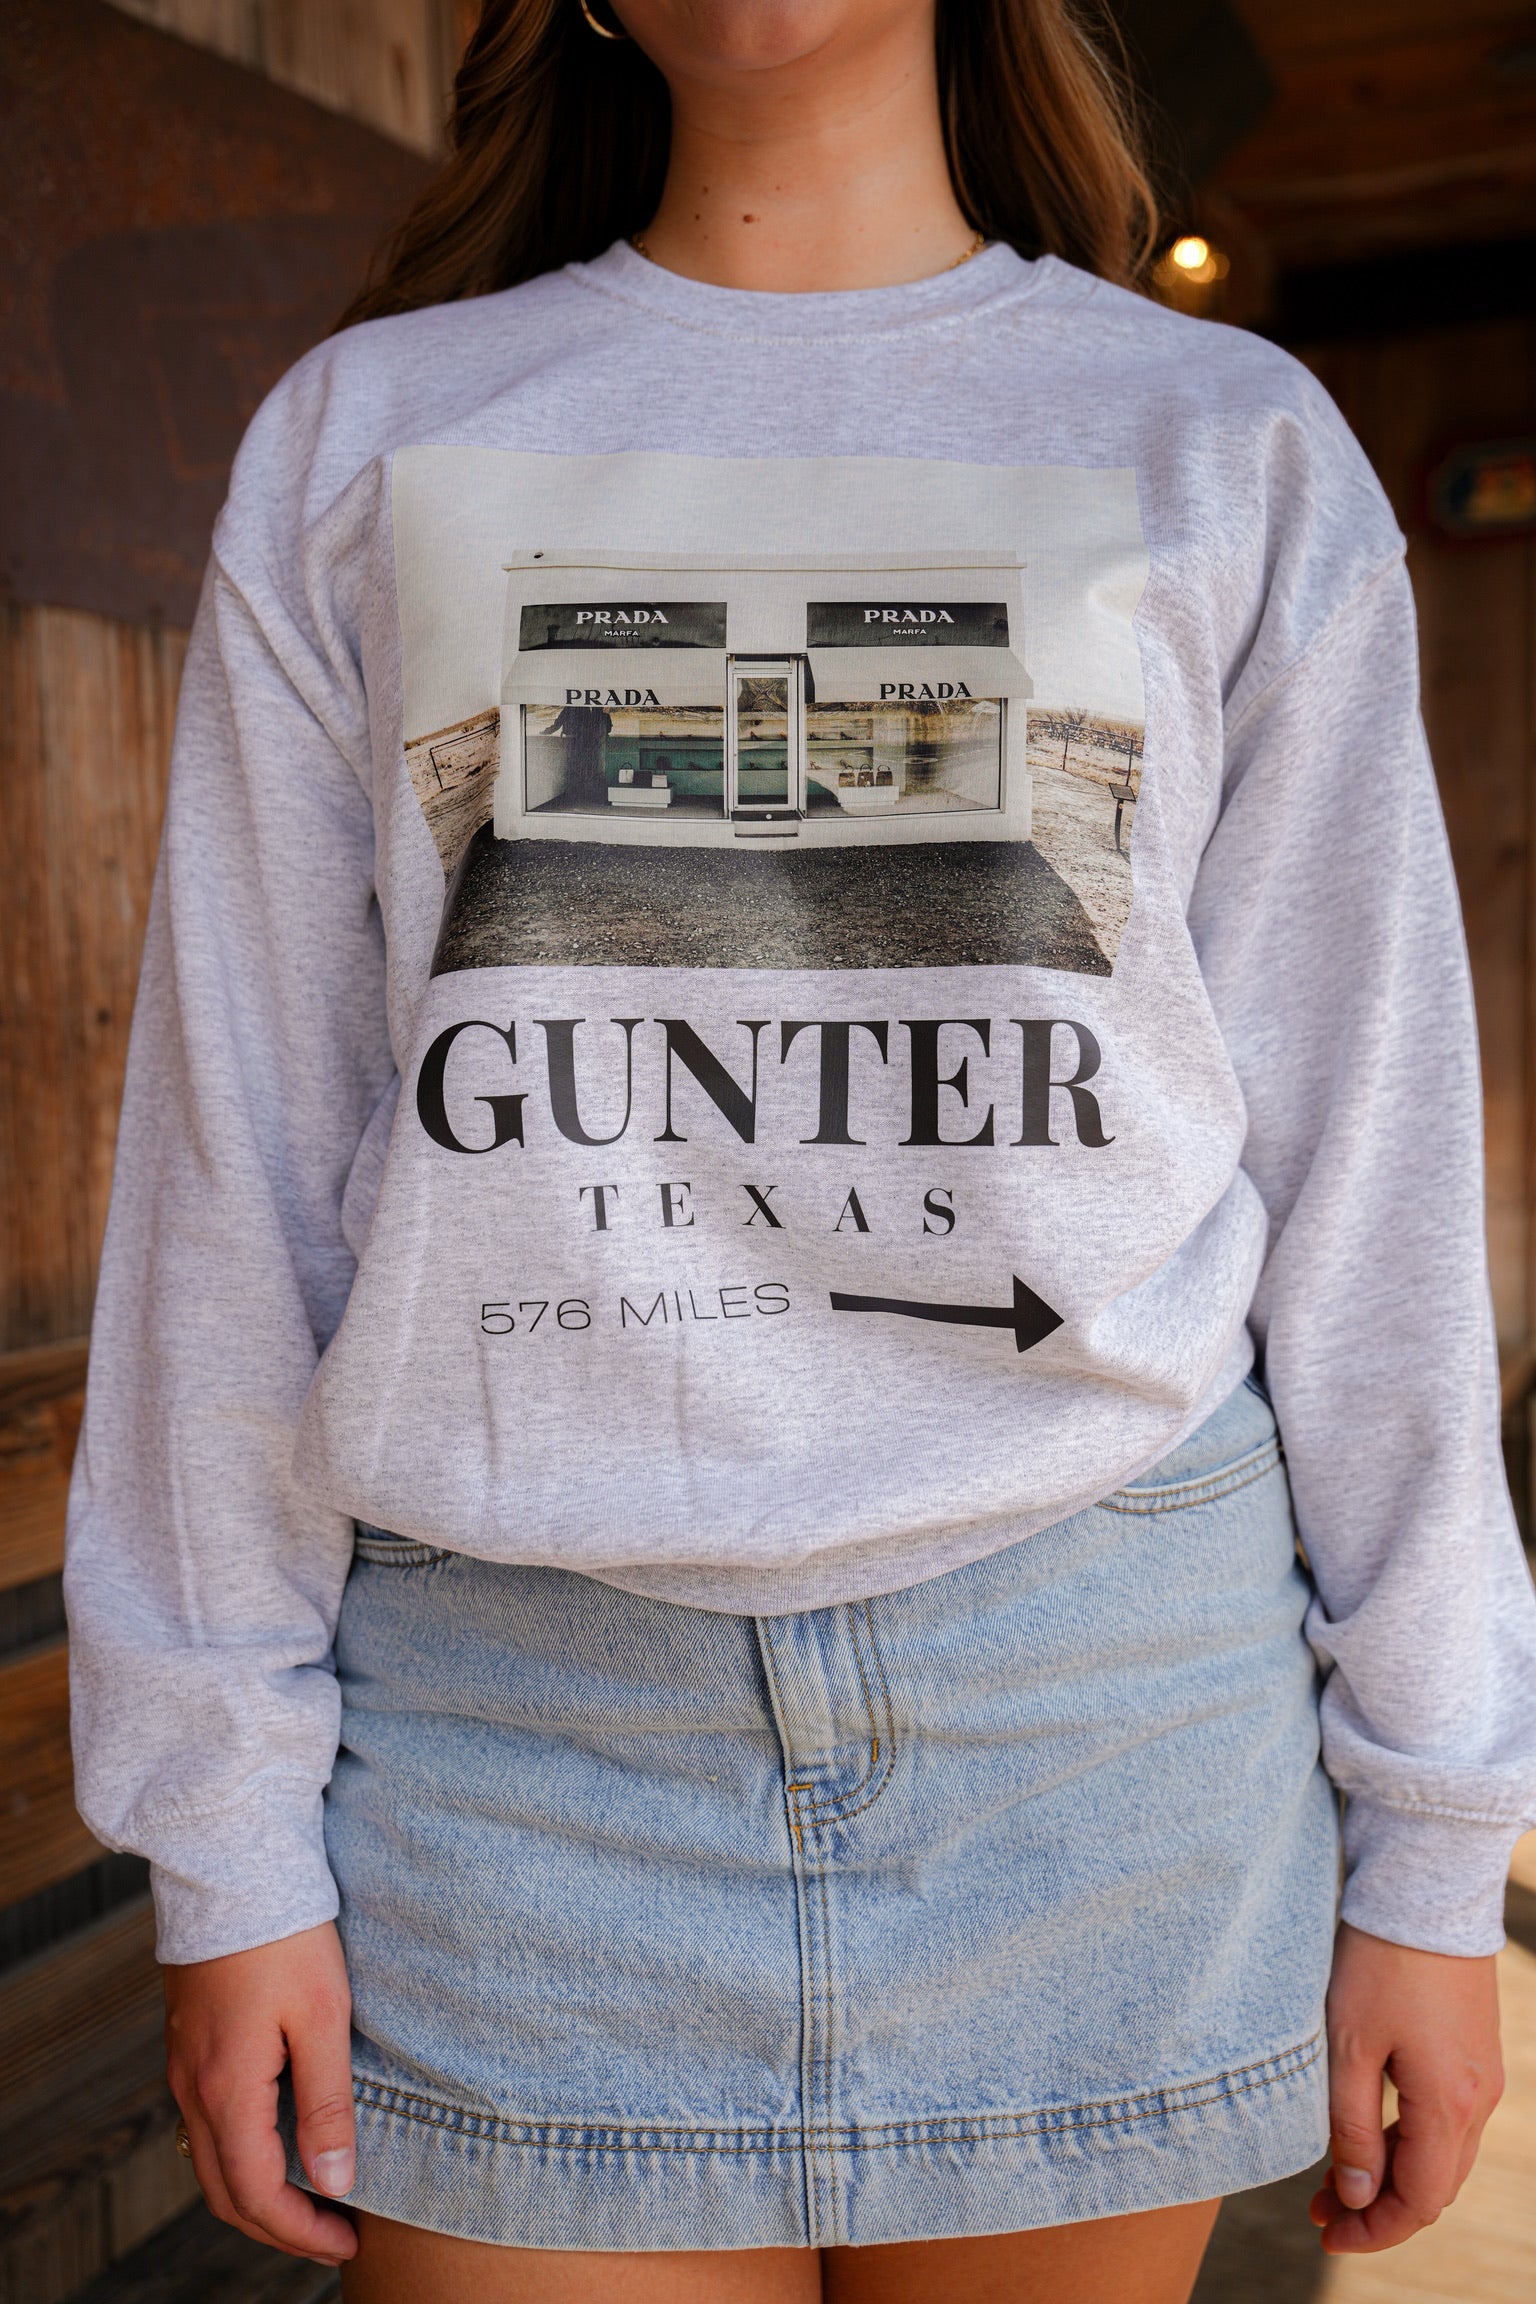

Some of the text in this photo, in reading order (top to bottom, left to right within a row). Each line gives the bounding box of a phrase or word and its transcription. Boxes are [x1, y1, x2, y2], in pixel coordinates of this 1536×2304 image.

[576, 610, 669, 625] PRADA
[863, 609, 955, 624] PRADA
[893, 628, 927, 636] MARFA
[565, 688, 661, 706] PRADA
[880, 681, 972, 700] PRADA
[416, 1017, 1116, 1154] GUNTER
[579, 1182, 956, 1236] TEXAS
[480, 1283, 791, 1335] 576 MILES
